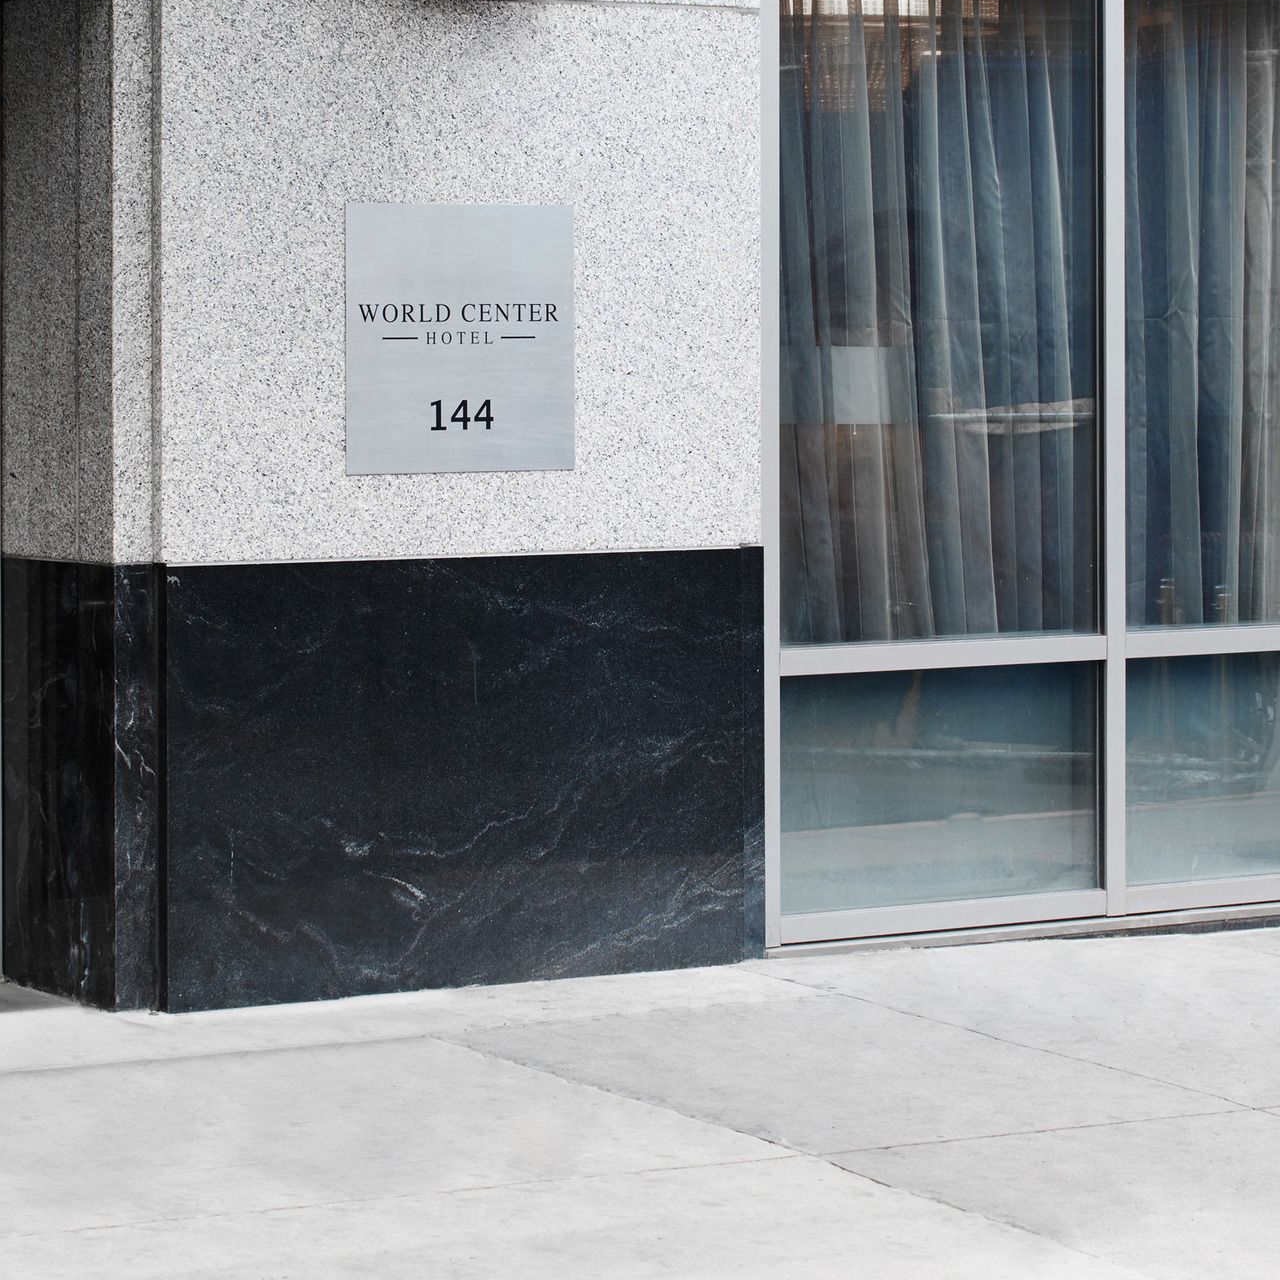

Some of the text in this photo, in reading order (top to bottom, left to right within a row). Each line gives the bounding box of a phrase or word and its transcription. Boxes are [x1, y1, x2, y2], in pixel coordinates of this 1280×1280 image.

[358, 303, 560, 323] WORLD CENTER
[425, 331, 494, 345] HOTEL
[430, 399, 494, 431] 144
